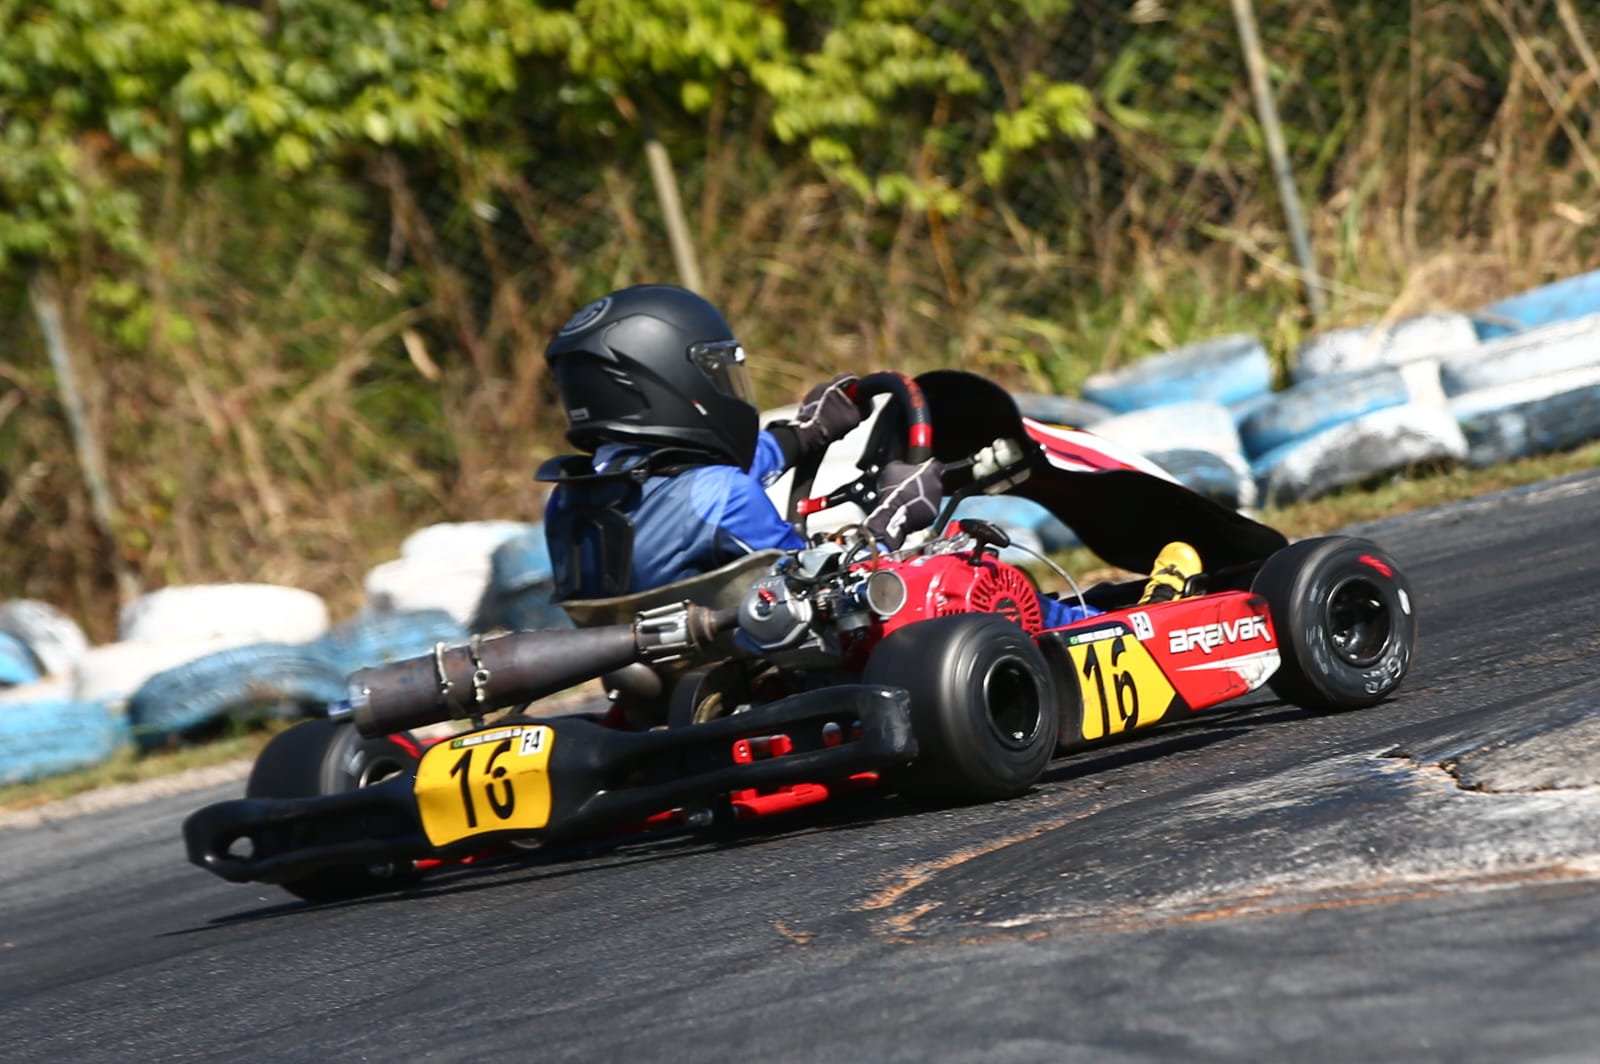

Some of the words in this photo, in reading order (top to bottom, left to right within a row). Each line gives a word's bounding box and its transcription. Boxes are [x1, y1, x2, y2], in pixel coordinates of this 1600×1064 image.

[1083, 636, 1139, 735] 16
[450, 739, 515, 828] 16
[521, 730, 541, 753] F4
